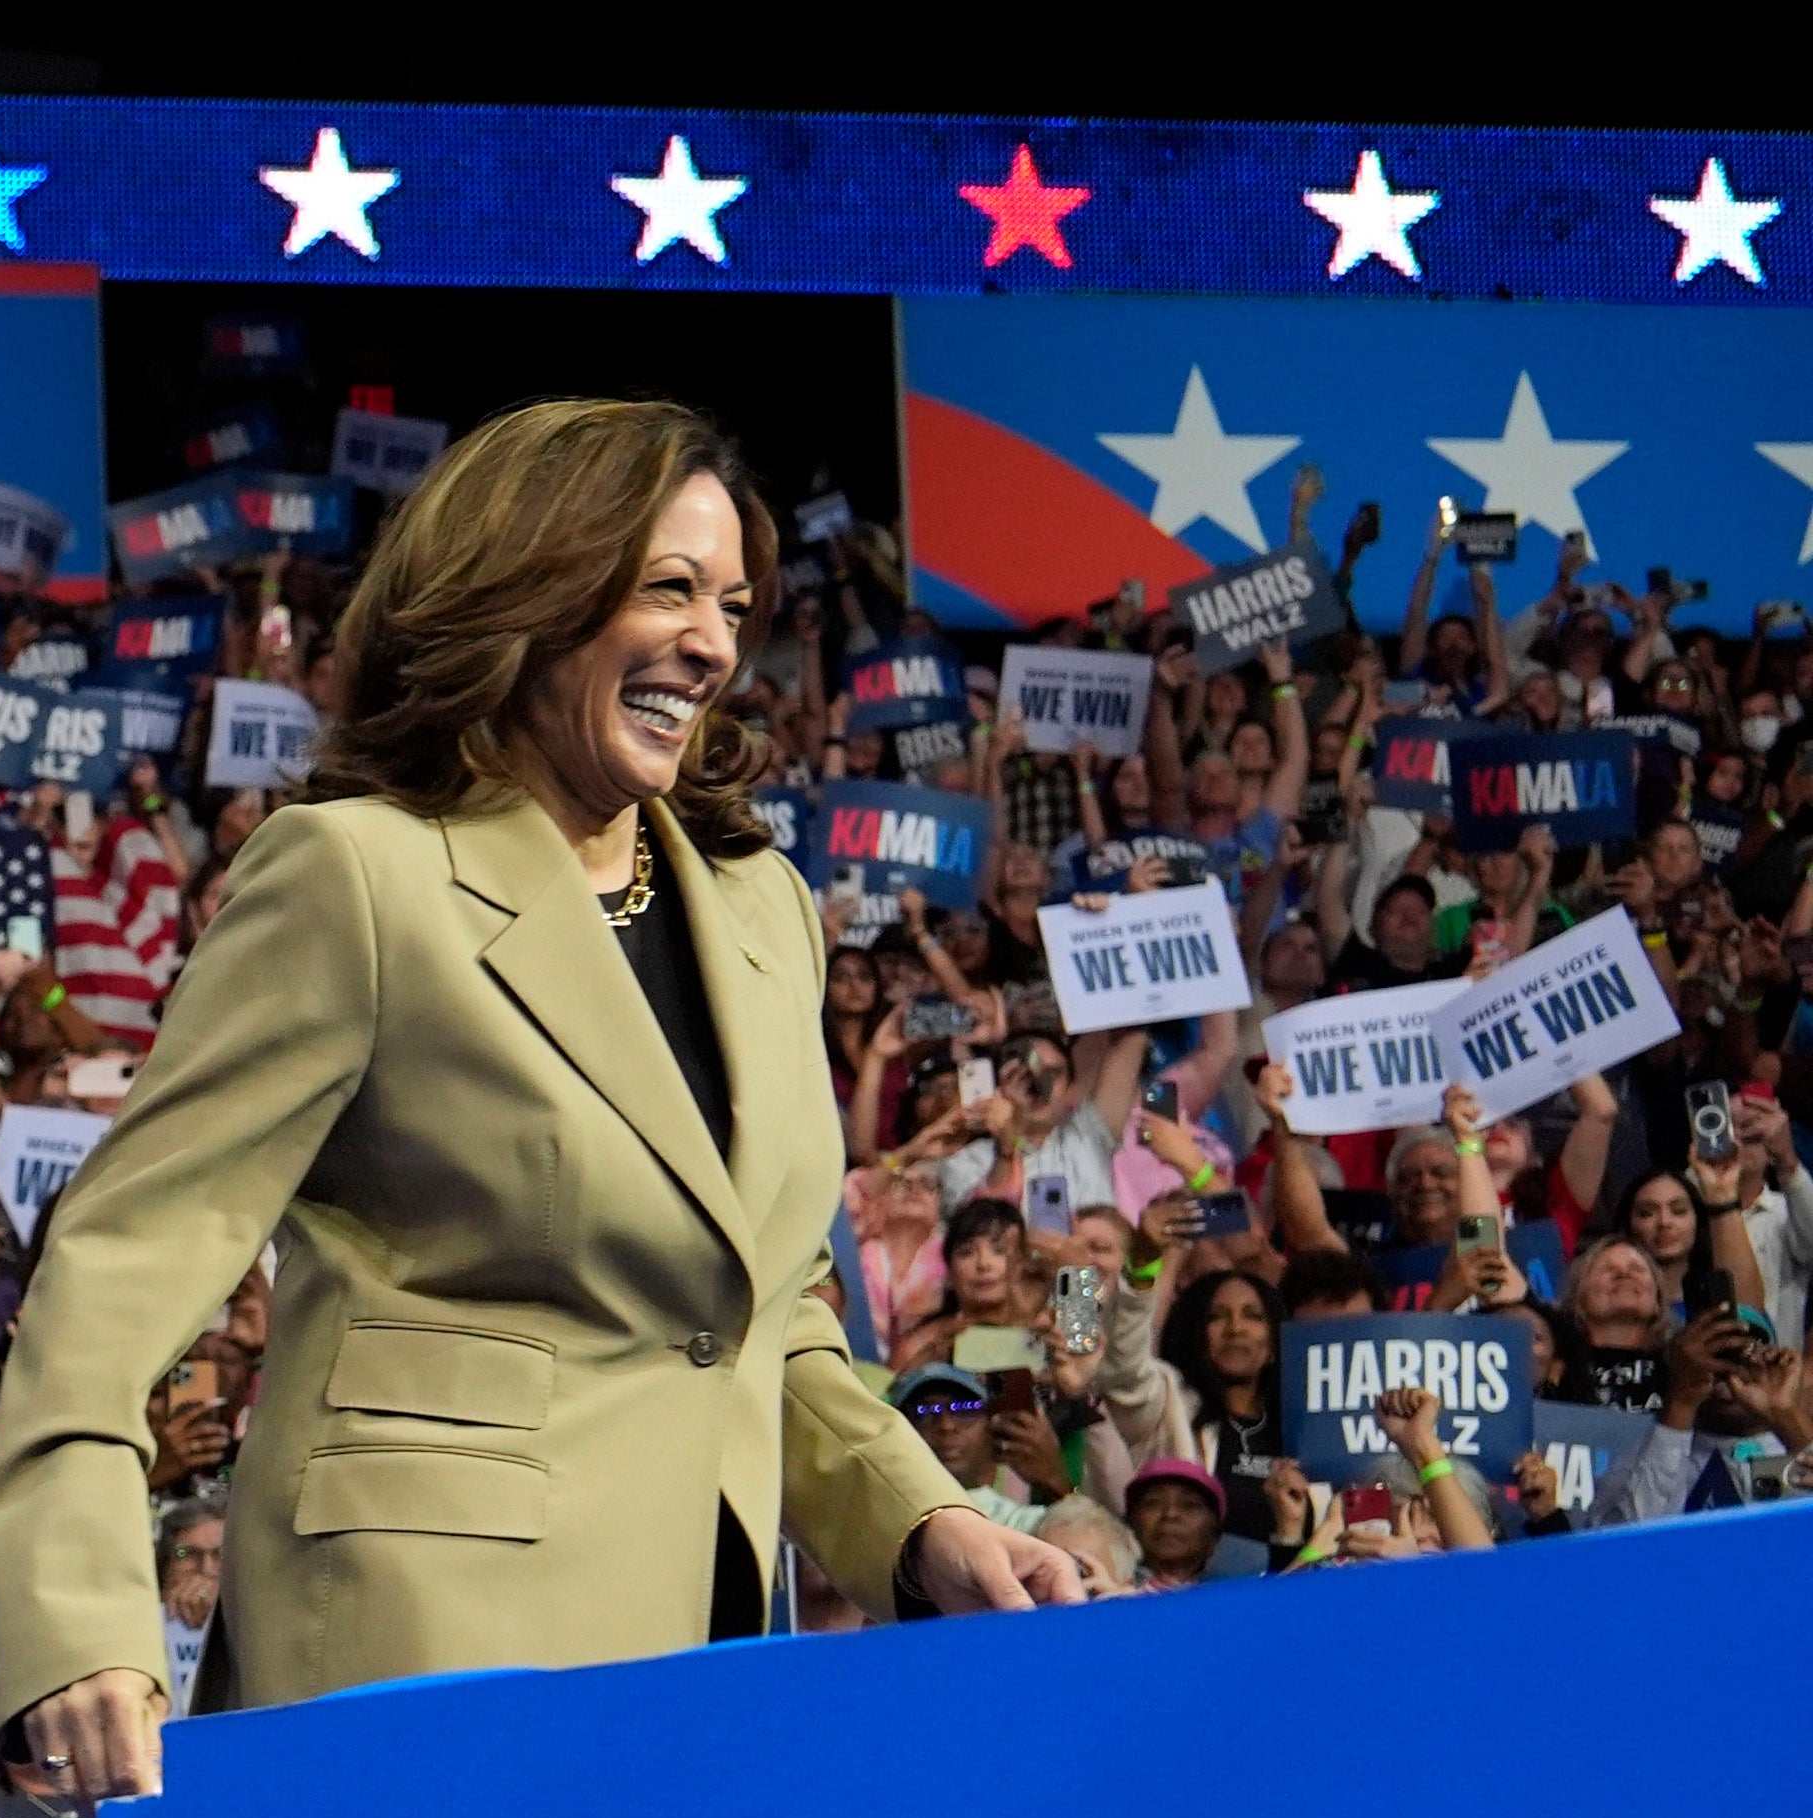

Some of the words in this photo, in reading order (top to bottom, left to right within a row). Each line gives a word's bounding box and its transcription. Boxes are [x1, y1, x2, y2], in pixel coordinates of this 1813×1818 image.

[1183, 559, 1315, 637] HARRIS
[1221, 602, 1306, 652] WALZ
[44, 706, 108, 757] RIS
[1021, 684, 1063, 723] WE
[1072, 686, 1132, 728] WIN
[1470, 758, 1619, 815] KAMALA
[828, 806, 974, 878] KAMALA
[1069, 924, 1125, 942] WHEN
[1129, 919, 1155, 935] WE
[1160, 912, 1205, 931] VOTE
[1073, 947, 1135, 993] WE
[1136, 931, 1221, 985] WIN
[1459, 993, 1520, 1032] WHEN
[1520, 977, 1554, 1005] WE
[1555, 943, 1611, 990] VOTE
[1295, 1022, 1357, 1046] WHEN
[1361, 1017, 1393, 1036] WE
[1463, 1018, 1537, 1082] WE
[1530, 962, 1638, 1047] WIN
[1295, 1046, 1364, 1099] WE
[1306, 1338, 1509, 1414] HARRIS
[1341, 1415, 1481, 1456] WZ
